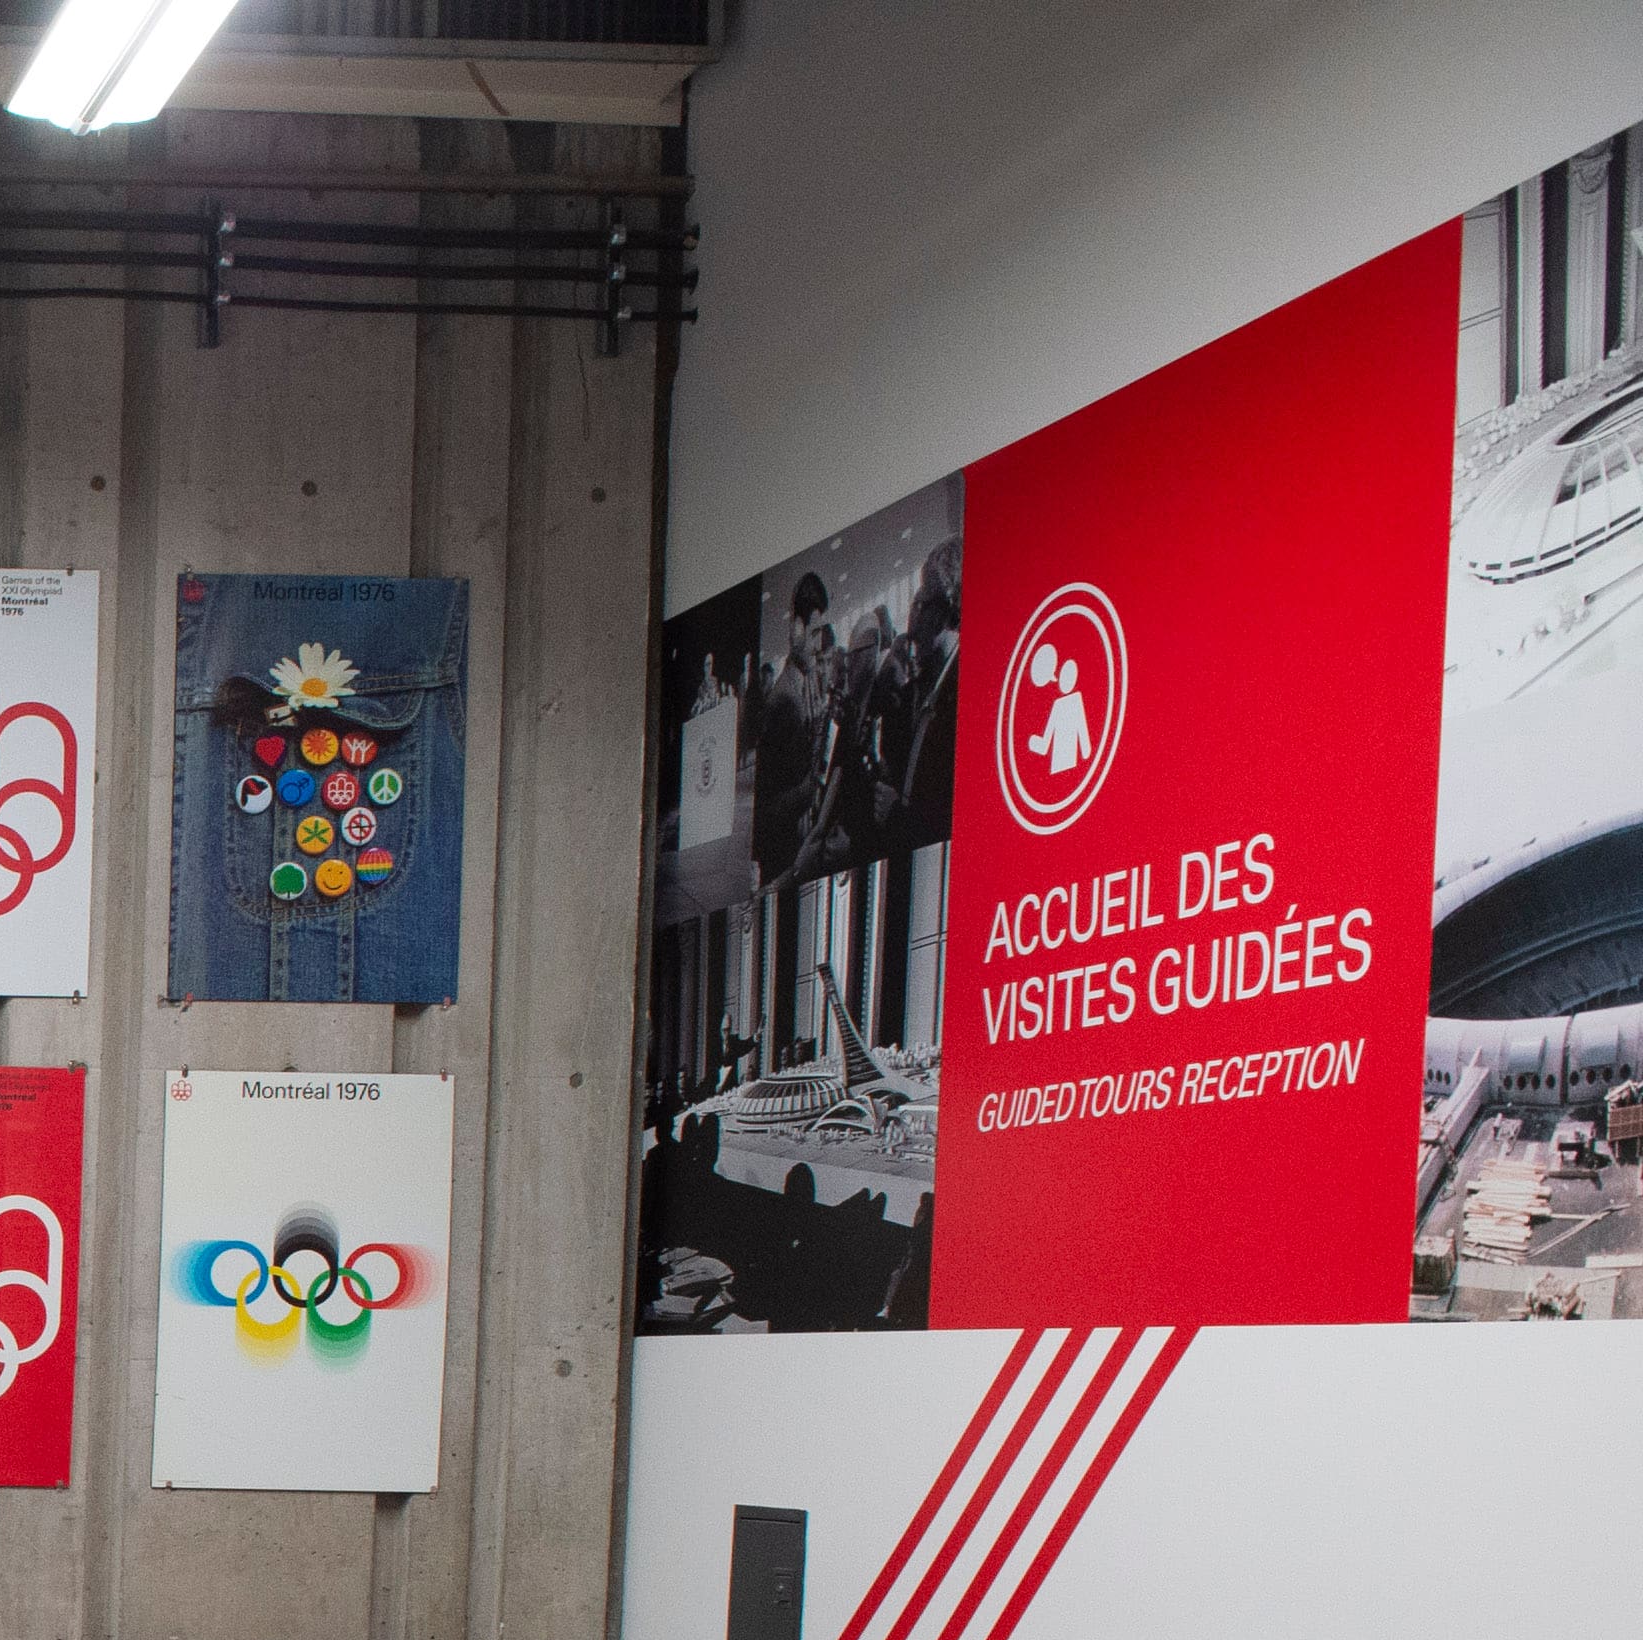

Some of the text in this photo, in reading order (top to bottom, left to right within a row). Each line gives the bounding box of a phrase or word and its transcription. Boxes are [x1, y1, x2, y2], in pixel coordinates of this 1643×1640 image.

[1, 596, 49, 606] Montréal
[349, 583, 395, 601] 1976
[0, 607, 24, 616] 1976
[985, 832, 1276, 964] ACCUEIL DES
[982, 904, 1374, 1046] VISITES GUIDÉES
[241, 1081, 381, 1101] Montréal 1976
[977, 1038, 1366, 1133] GUIDED TOURS RECEPTION
